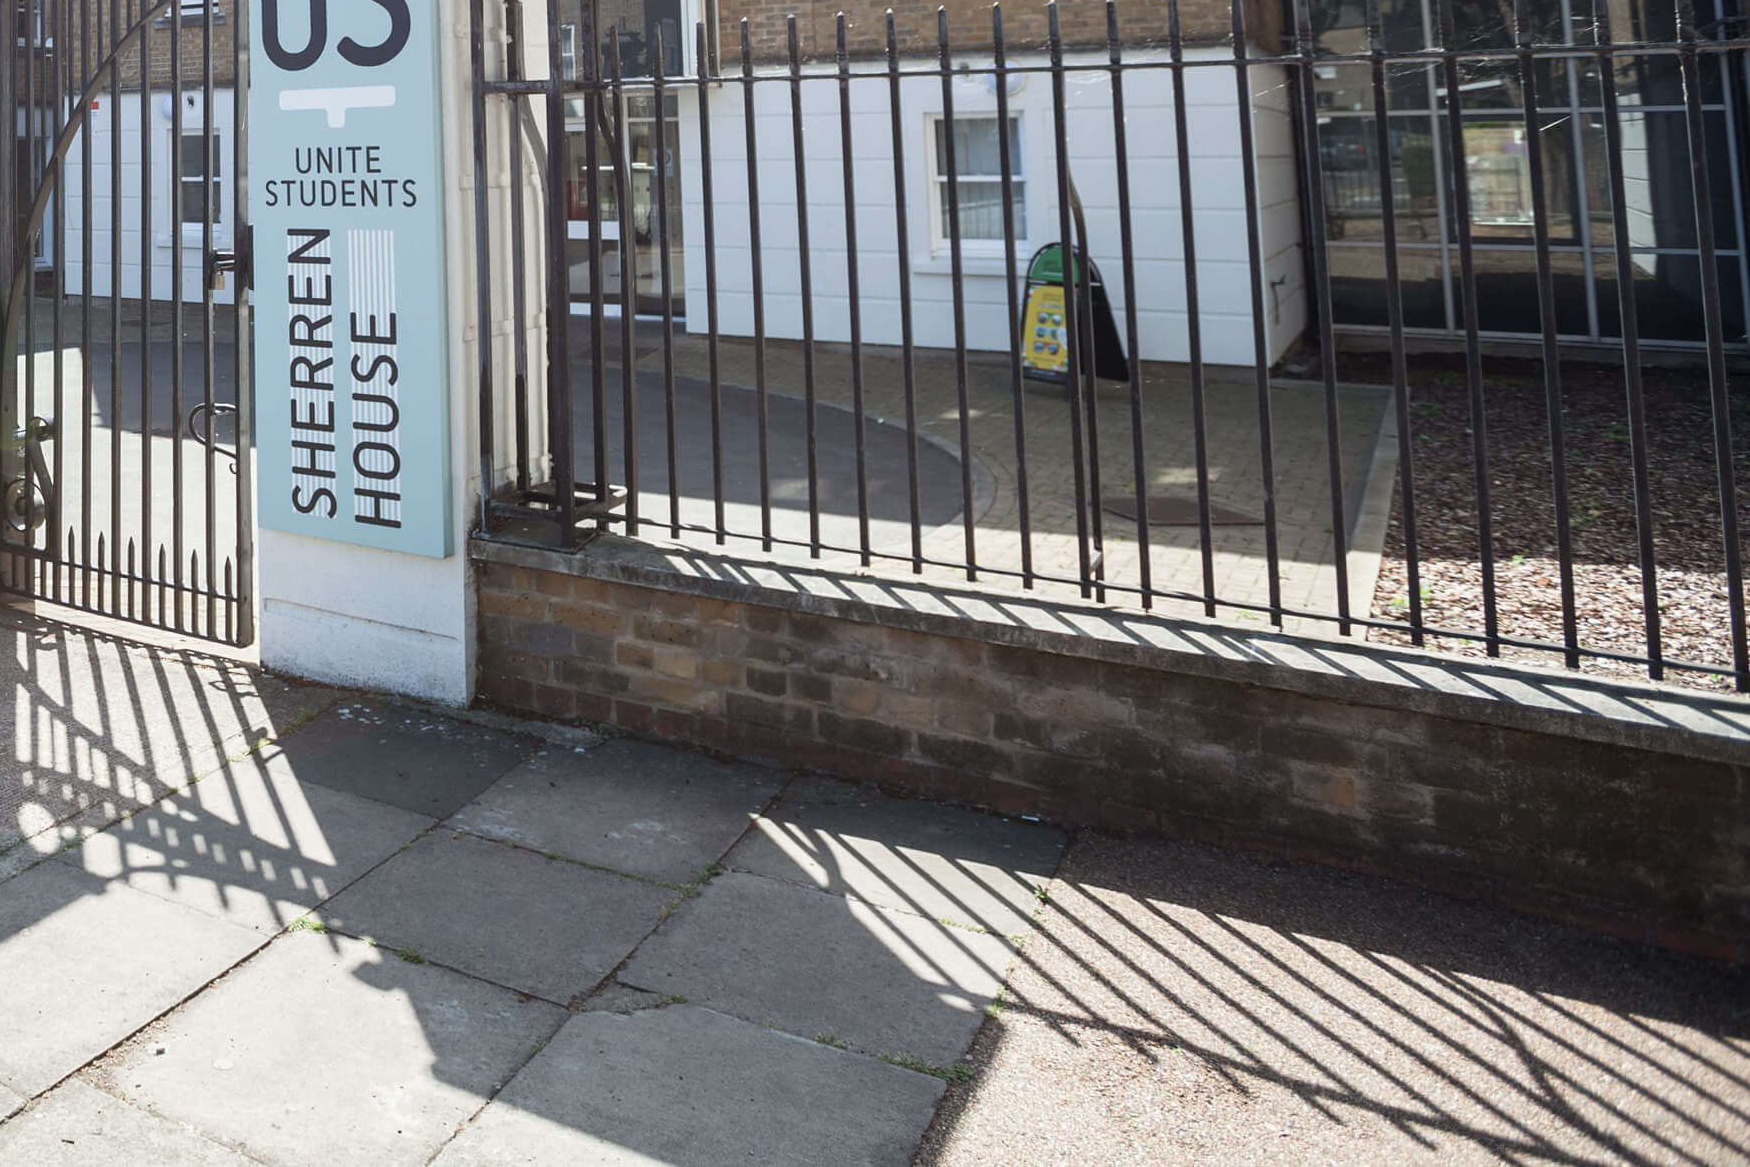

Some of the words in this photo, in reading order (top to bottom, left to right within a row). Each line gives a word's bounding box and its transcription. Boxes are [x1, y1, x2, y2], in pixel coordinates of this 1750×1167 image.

[265, 179, 418, 208] STUDENTS
[295, 146, 382, 174] UNITE
[286, 228, 338, 519] SHERREN
[350, 312, 402, 529] HOUSE
